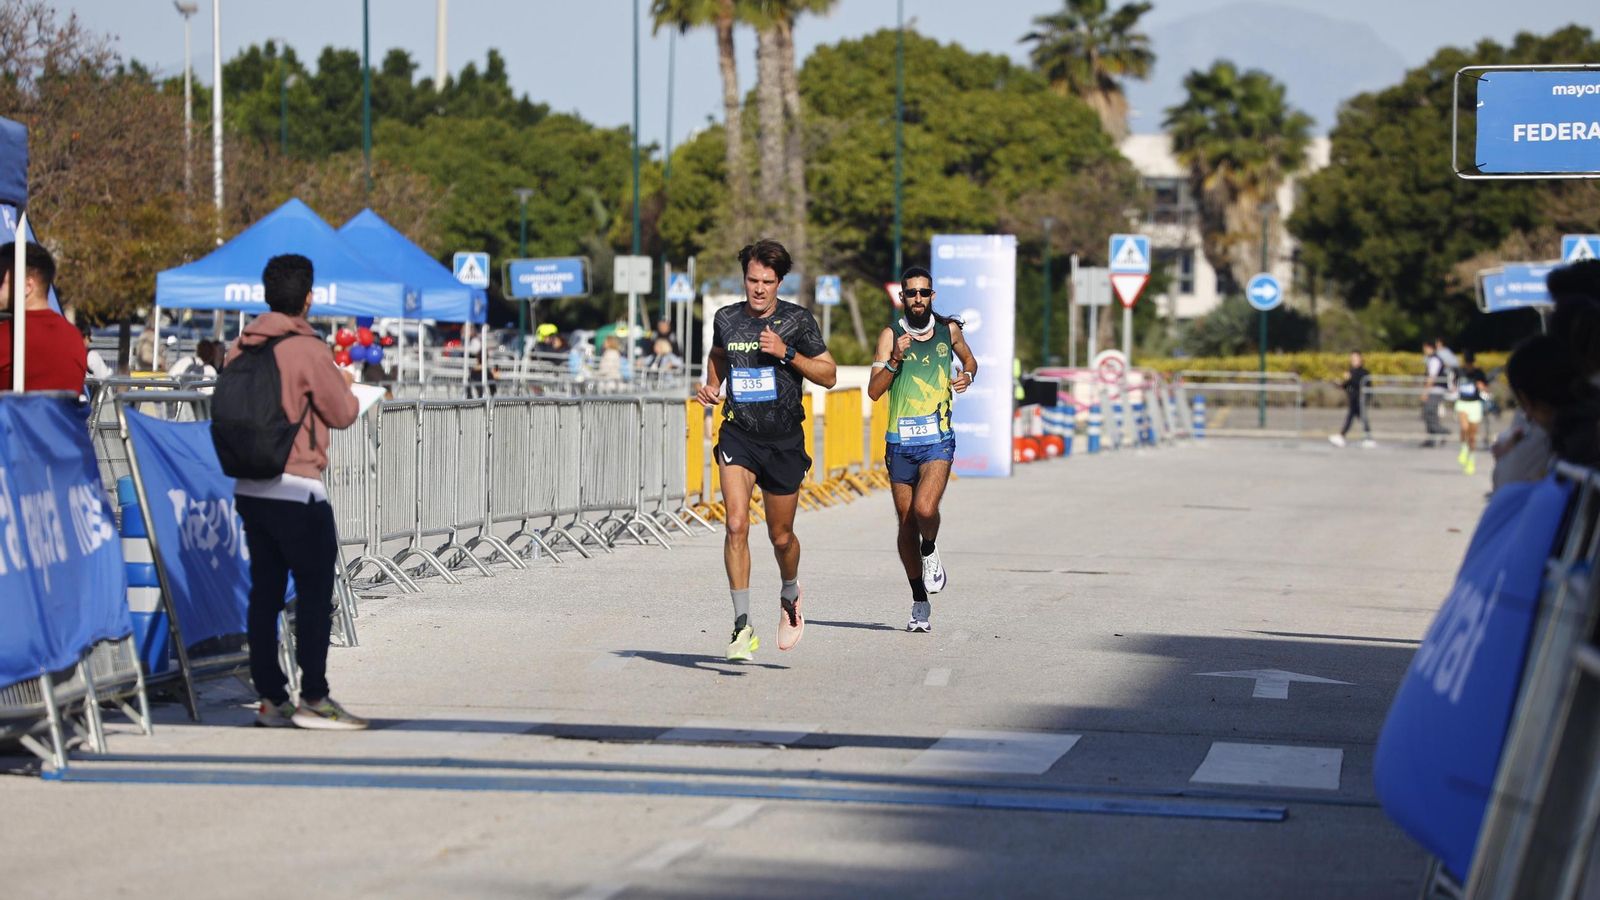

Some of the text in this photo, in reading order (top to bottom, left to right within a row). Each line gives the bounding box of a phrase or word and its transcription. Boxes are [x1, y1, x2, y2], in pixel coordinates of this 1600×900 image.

[1513, 121, 1600, 142] FEDERA
[224, 283, 337, 305] maal
[727, 341, 761, 353] mayo
[741, 379, 763, 390] 335
[910, 425, 929, 435] 123
